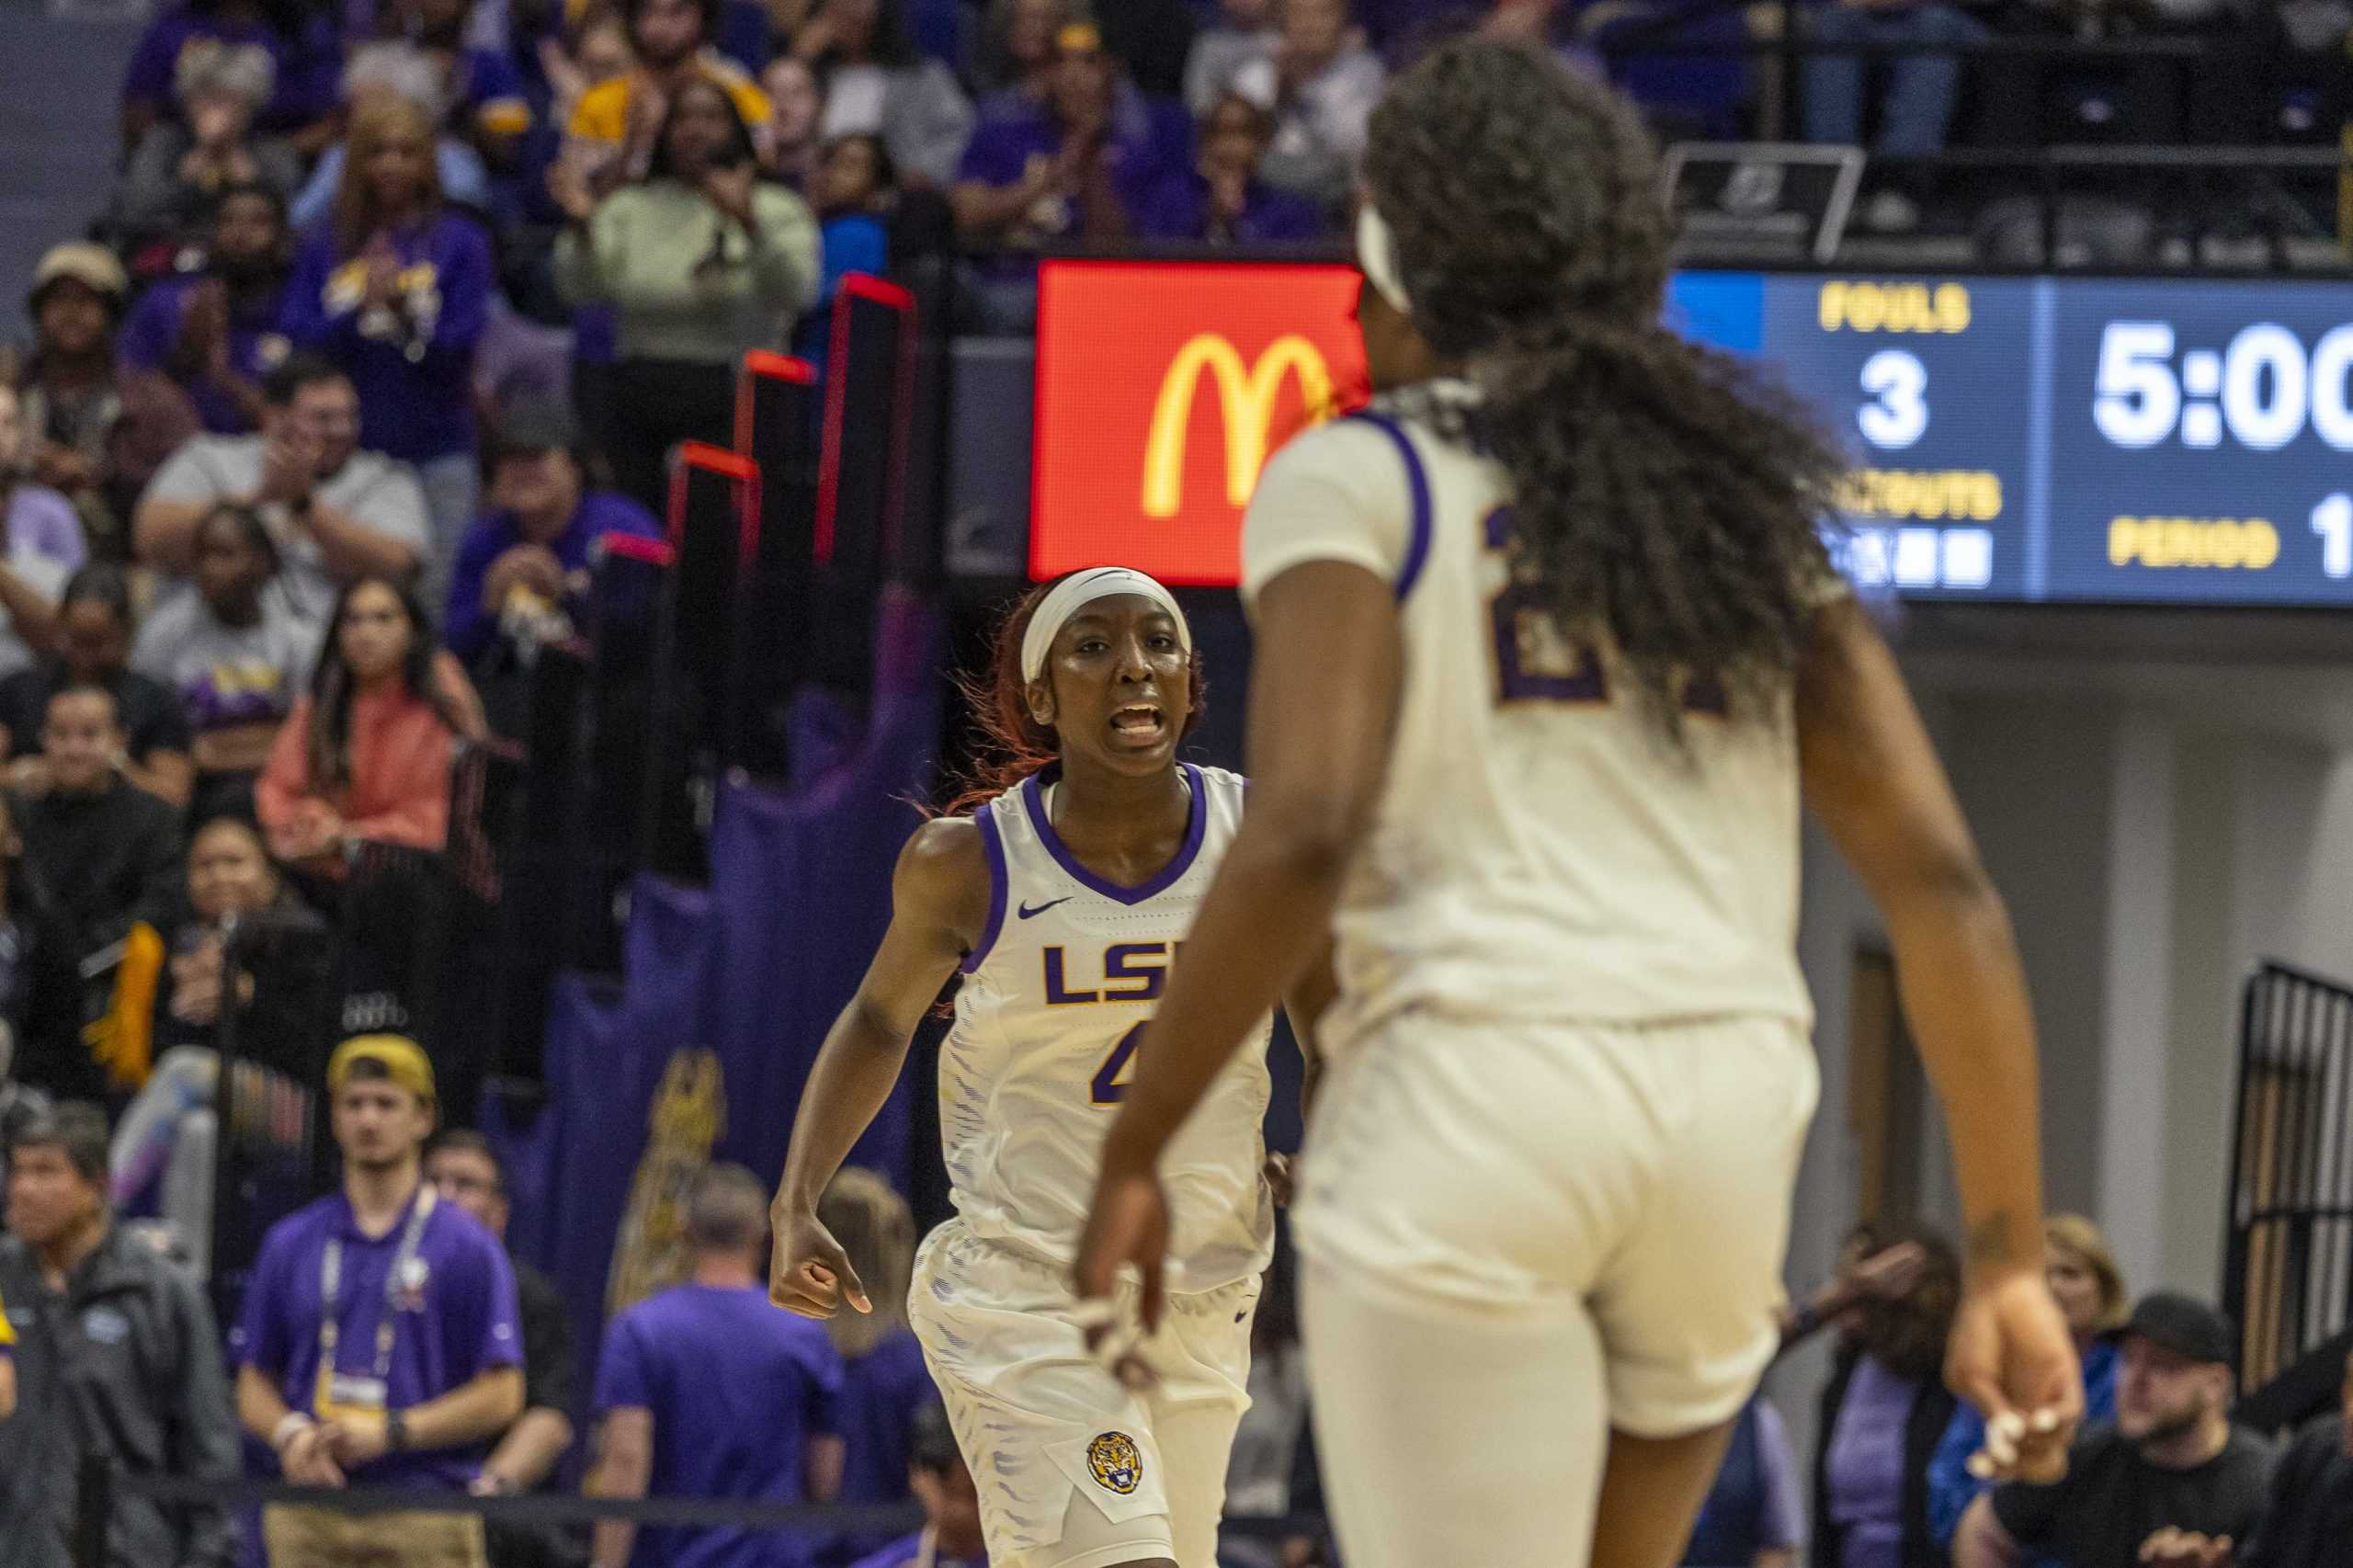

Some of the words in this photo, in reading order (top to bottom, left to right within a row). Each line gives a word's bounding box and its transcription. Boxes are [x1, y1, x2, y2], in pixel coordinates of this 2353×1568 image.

[1818, 280, 1971, 333] FOULS
[1858, 349, 1927, 449] 3
[2092, 320, 2353, 450] 5:00
[2108, 516, 2280, 568] PERIOD
[2309, 492, 2353, 578] 1
[1042, 940, 1180, 1007] LS
